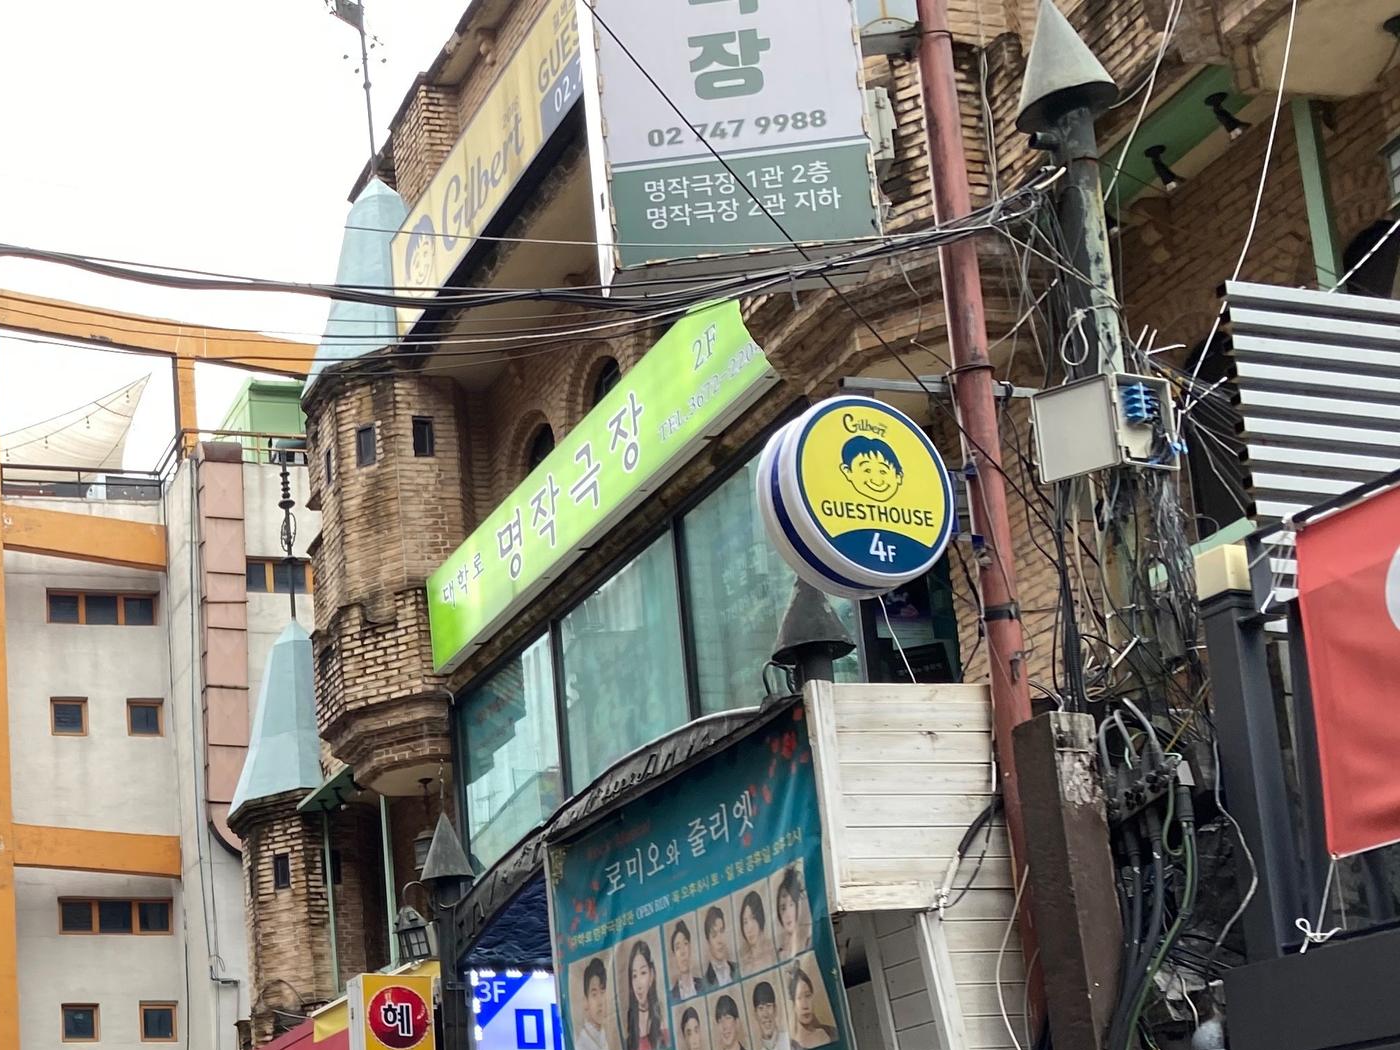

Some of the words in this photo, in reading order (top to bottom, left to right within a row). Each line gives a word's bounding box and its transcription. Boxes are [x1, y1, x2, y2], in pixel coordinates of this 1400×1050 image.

[647, 126, 684, 147] 02
[692, 118, 745, 142] 747
[754, 109, 827, 135] 9988
[441, 114, 525, 252] Gilbert
[644, 171, 736, 202] 명작극장
[747, 165, 785, 190] 1관
[791, 160, 832, 185] 2층
[646, 198, 740, 230] 명작극장
[747, 192, 787, 217] 2관
[794, 186, 843, 212] 지하
[692, 322, 717, 371] 2F
[442, 552, 485, 608] 대학로
[496, 391, 645, 579] 명작극장
[821, 499, 935, 527] GUESTHOUSE
[869, 532, 897, 563] 4F
[604, 838, 681, 896] 로미오와
[687, 789, 754, 859] 줄리엣
[478, 980, 507, 1003] 3F
